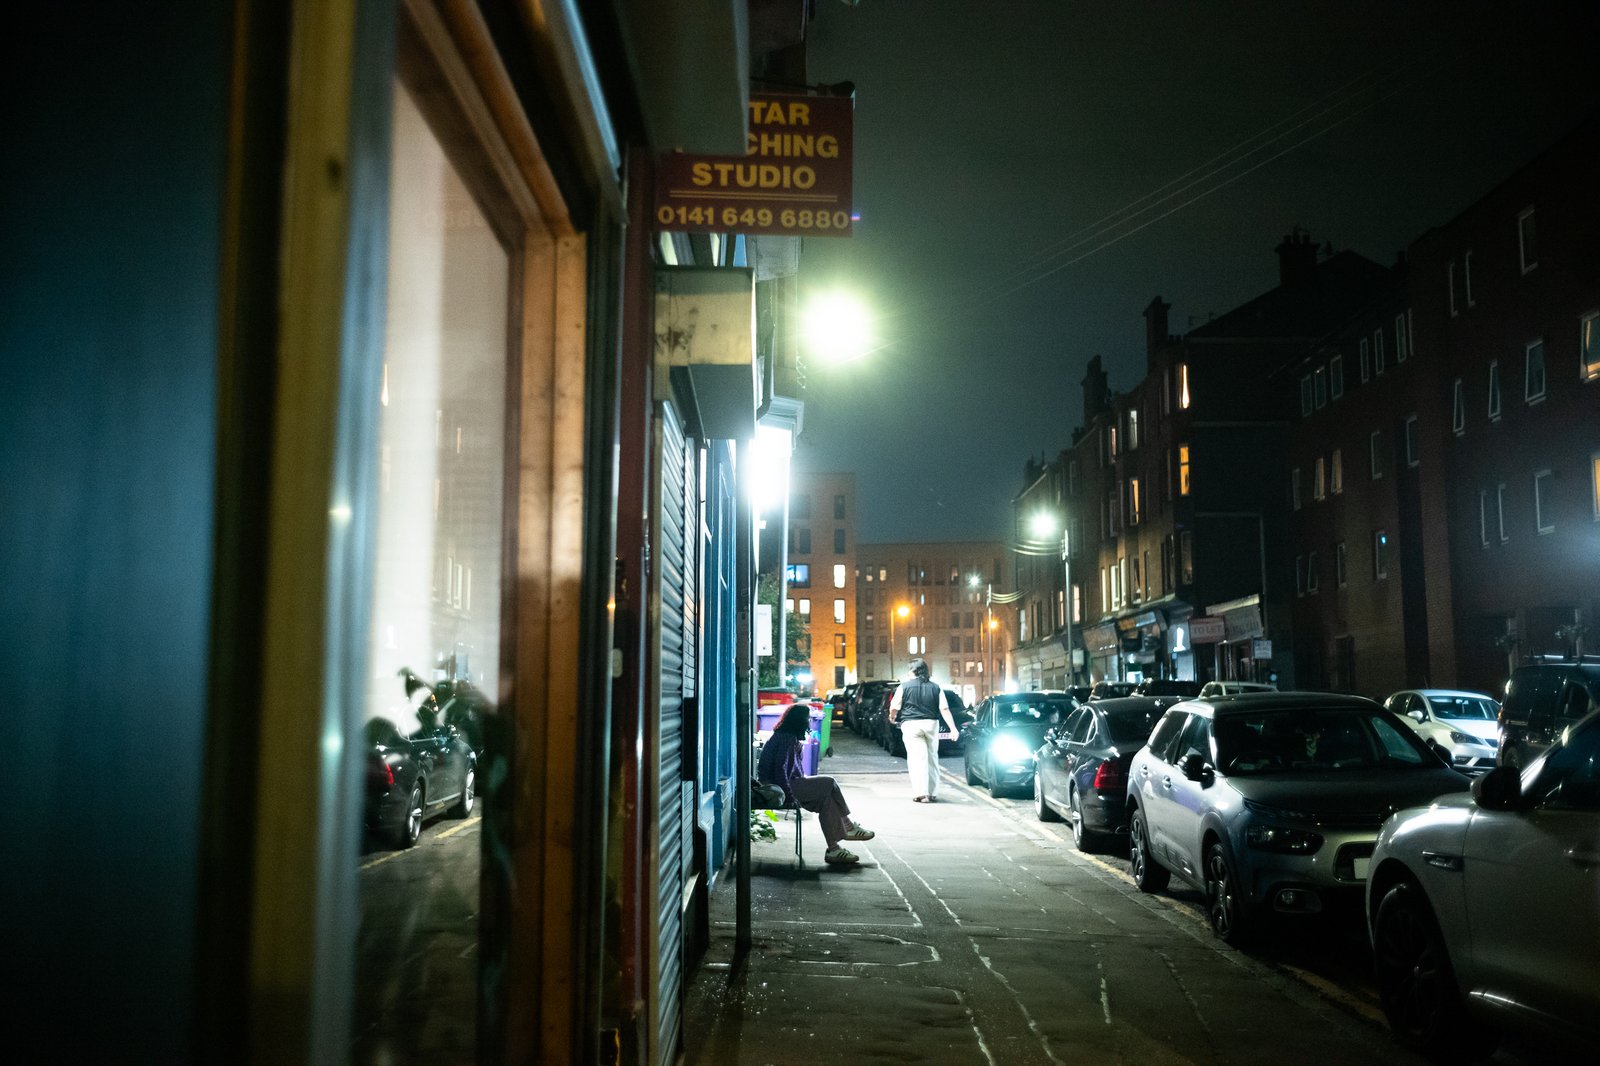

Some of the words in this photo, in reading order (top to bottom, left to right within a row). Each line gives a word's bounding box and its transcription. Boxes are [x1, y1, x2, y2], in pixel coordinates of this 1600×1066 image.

[748, 101, 810, 126] TAR
[746, 133, 839, 158] CHING
[692, 162, 816, 190] STUDIO
[657, 206, 715, 225] 0141
[722, 207, 773, 227] 649
[780, 209, 849, 229] 6880
